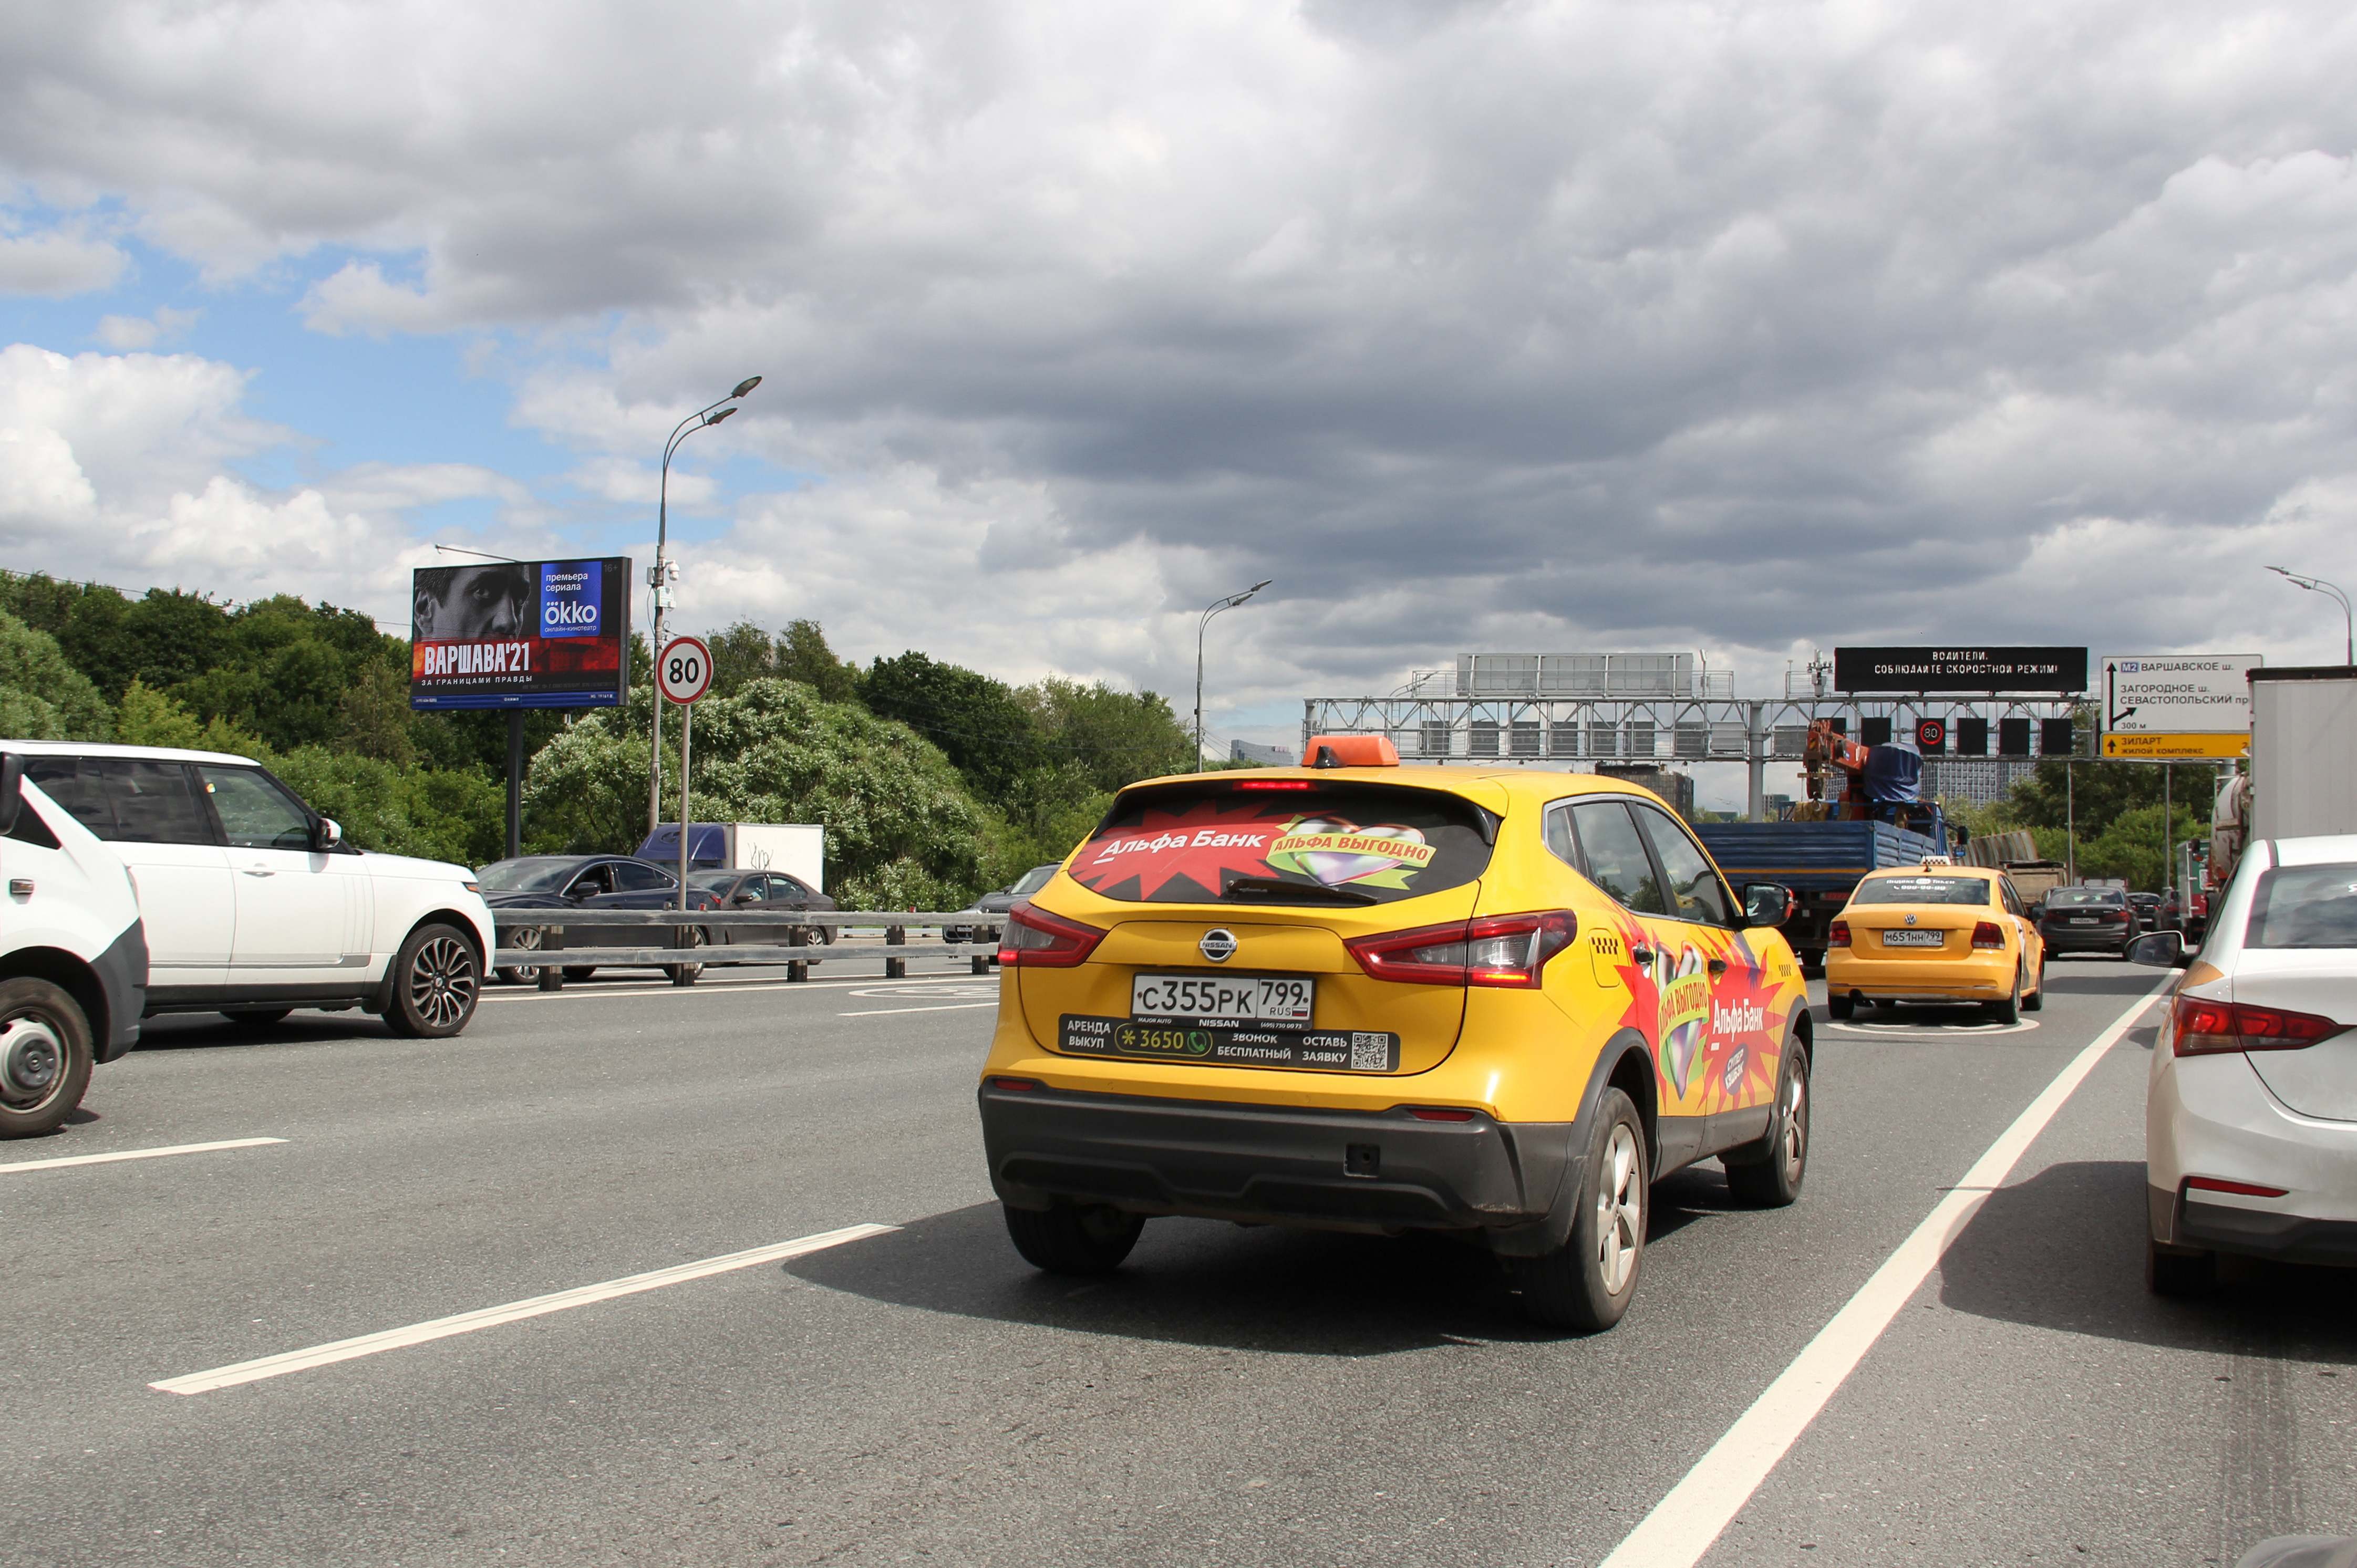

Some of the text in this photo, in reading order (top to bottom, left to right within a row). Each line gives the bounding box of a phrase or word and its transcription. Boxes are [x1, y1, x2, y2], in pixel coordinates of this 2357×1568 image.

[604, 564, 618, 572] 16+
[546, 573, 588, 583] премьера
[545, 584, 581, 593] сериала
[425, 642, 529, 675] ВАРШАВА'21
[670, 658, 699, 683] 80
[2018, 664, 2058, 673] РЕЖИМ!
[2141, 662, 2218, 671] ВАРШАВСКОЕ
[2121, 684, 2195, 693] ЗАГОРОДНОЕ
[2121, 694, 2232, 704] СЕВАСТОПОЛЬСКИЙ
[1924, 728, 1937, 738] 80
[1099, 830, 1267, 858] Альфа Банк
[1274, 836, 1428, 860] АЛЬФА ВЫГОДНО
[1885, 932, 1923, 942] М651НН
[1143, 981, 1304, 1013] С355РК 799
[1674, 981, 1707, 1015] ВЫГОДНО
[1269, 1007, 1291, 1016] RUS
[1199, 1019, 1239, 1027] NISSAN
[1713, 998, 1763, 1042] Альфа Банк
[1068, 1020, 1111, 1034] АРЕНДА
[1069, 1035, 1104, 1048] ВЫКУП
[1232, 1033, 1277, 1044] ЗВОНОК
[1303, 1036, 1347, 1047] ОСТАВЬ
[1217, 1046, 1291, 1060] БЕСПЛАТНЫЙ
[1302, 1051, 1347, 1063] ЗАЯВКУ
